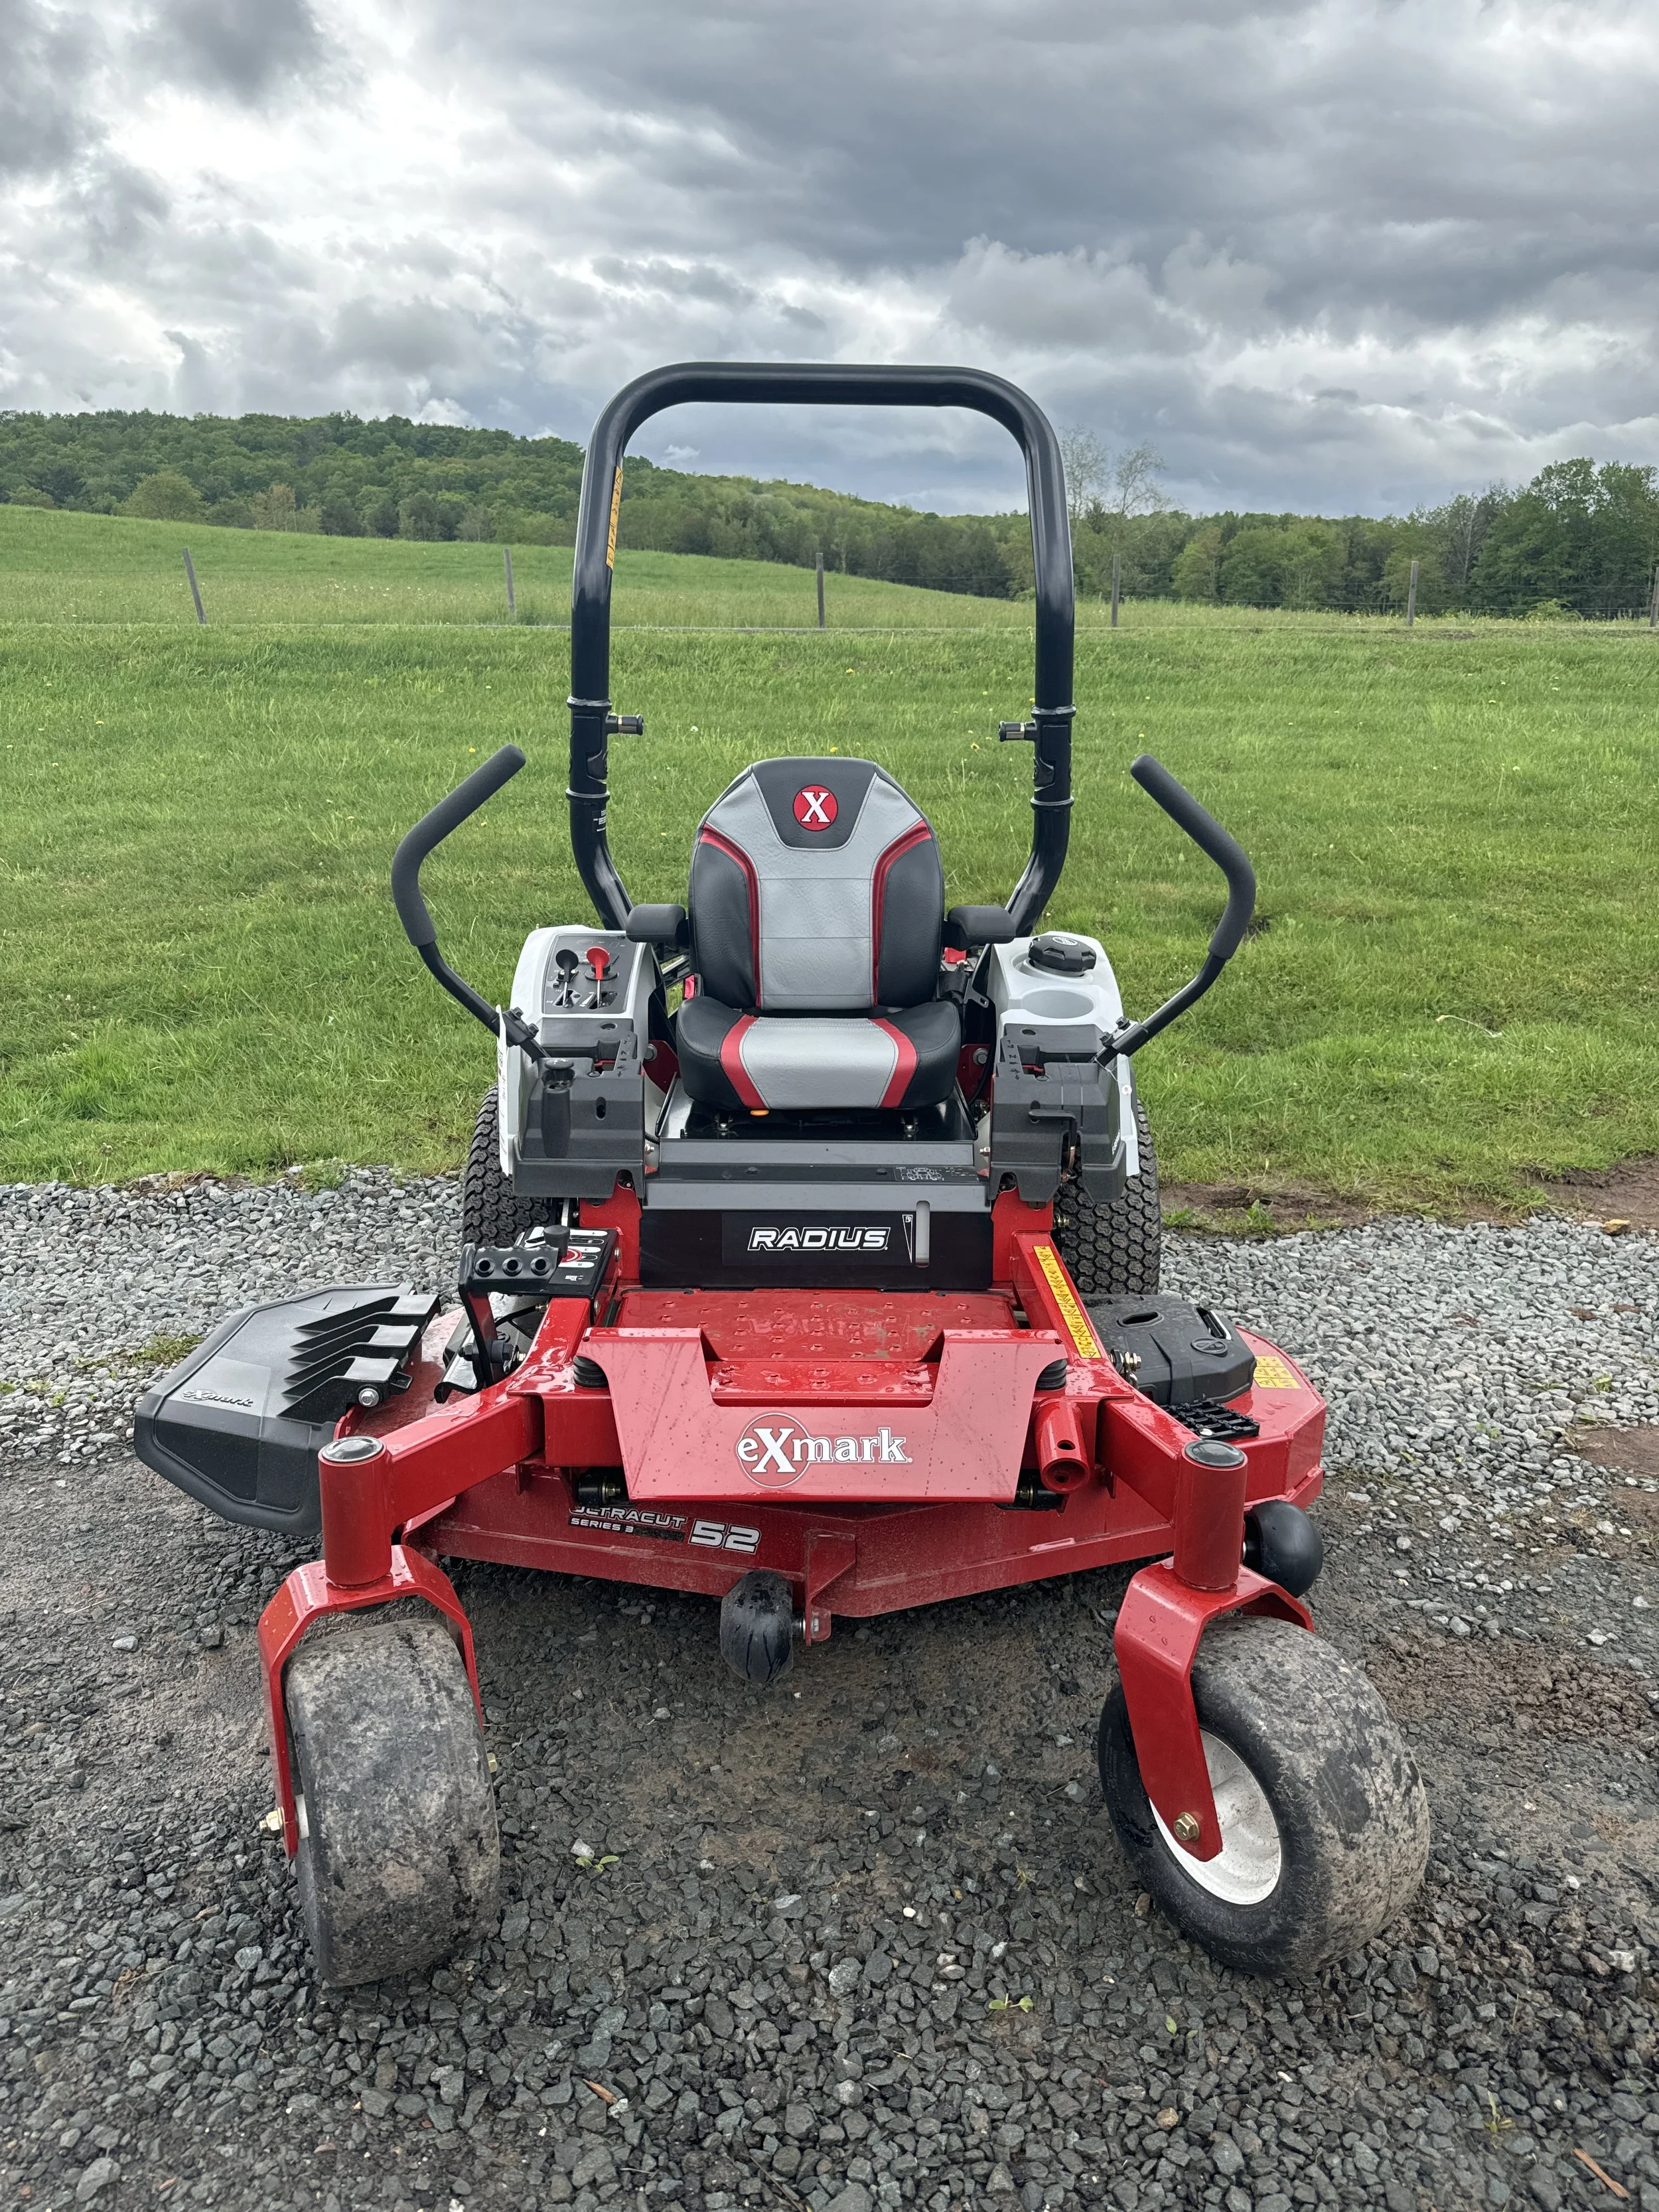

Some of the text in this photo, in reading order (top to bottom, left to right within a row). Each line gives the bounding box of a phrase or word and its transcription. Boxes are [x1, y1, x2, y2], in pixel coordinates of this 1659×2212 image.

[801, 792, 831, 822] X
[748, 1227, 891, 1250] RADIUS
[737, 1428, 908, 1473] eXmark
[571, 1518, 621, 1531] SERIES
[688, 1518, 761, 1554] 52
